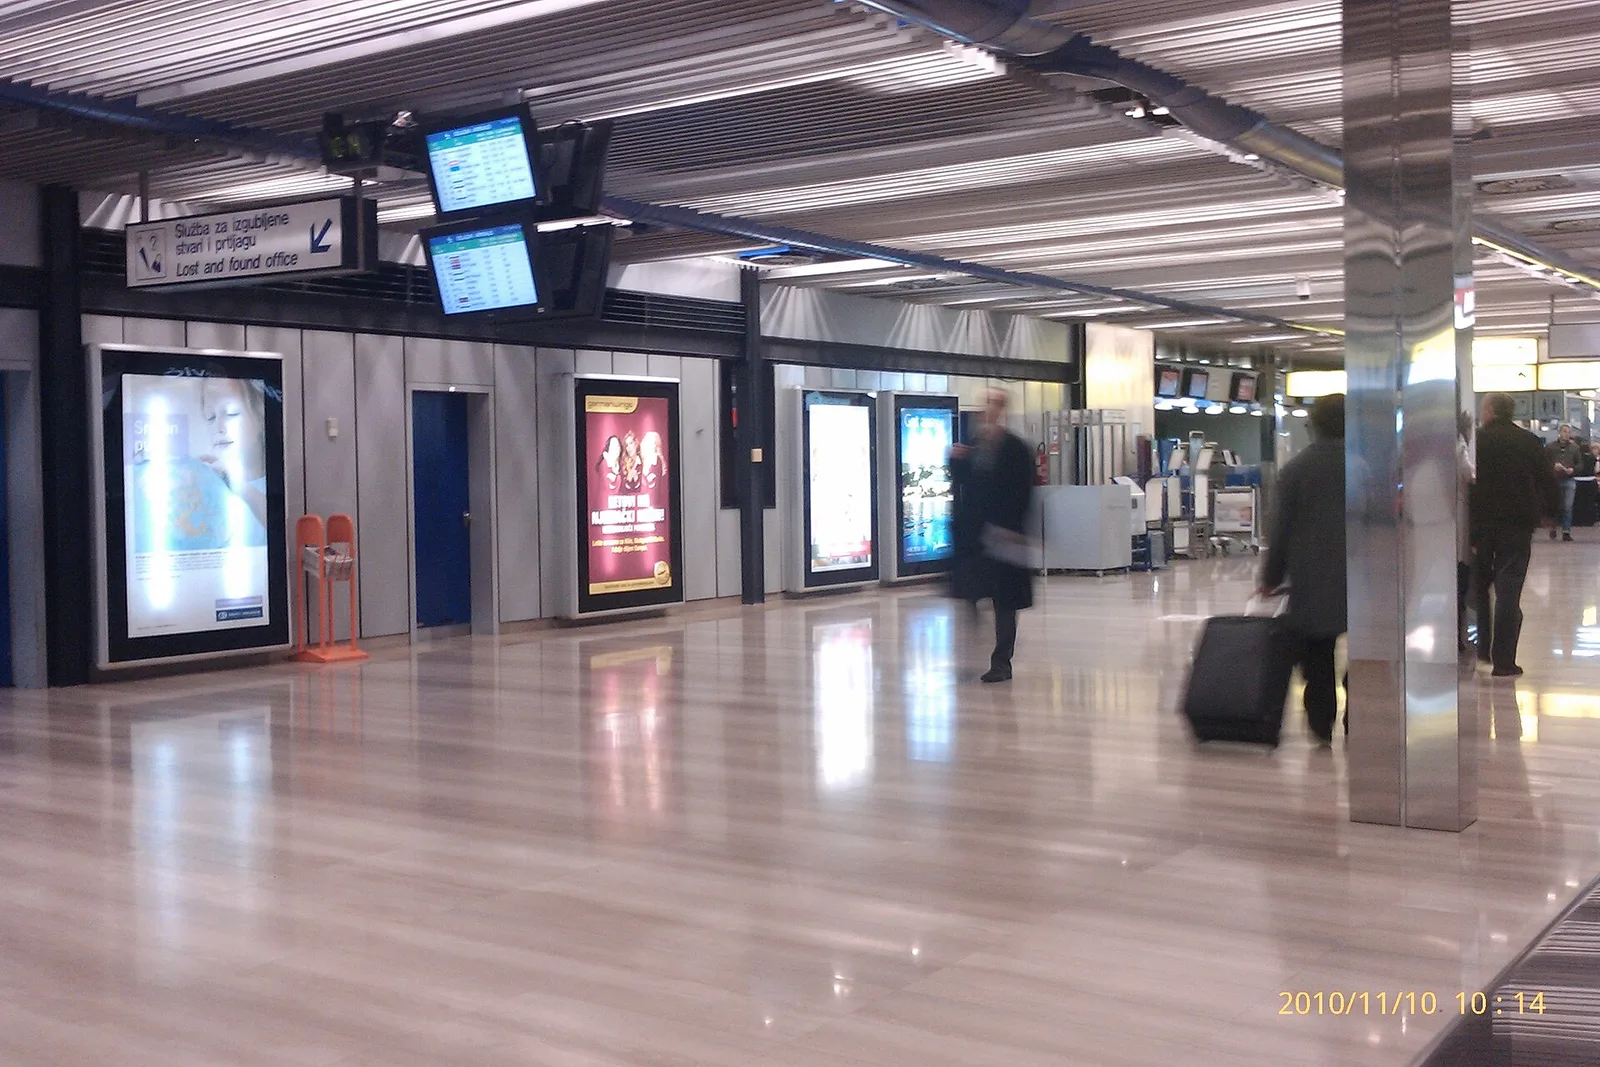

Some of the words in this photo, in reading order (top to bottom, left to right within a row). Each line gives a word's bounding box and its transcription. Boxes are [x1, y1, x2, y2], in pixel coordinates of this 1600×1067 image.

[174, 222, 210, 239] Služba
[214, 221, 228, 234] za
[232, 212, 290, 233] izgubljene
[175, 238, 203, 256] stvari
[215, 235, 257, 254] prtljagu
[176, 261, 199, 277] Lost
[203, 258, 224, 275] and
[229, 254, 261, 272] found
[265, 251, 298, 269] office
[587, 401, 633, 410] germanwings
